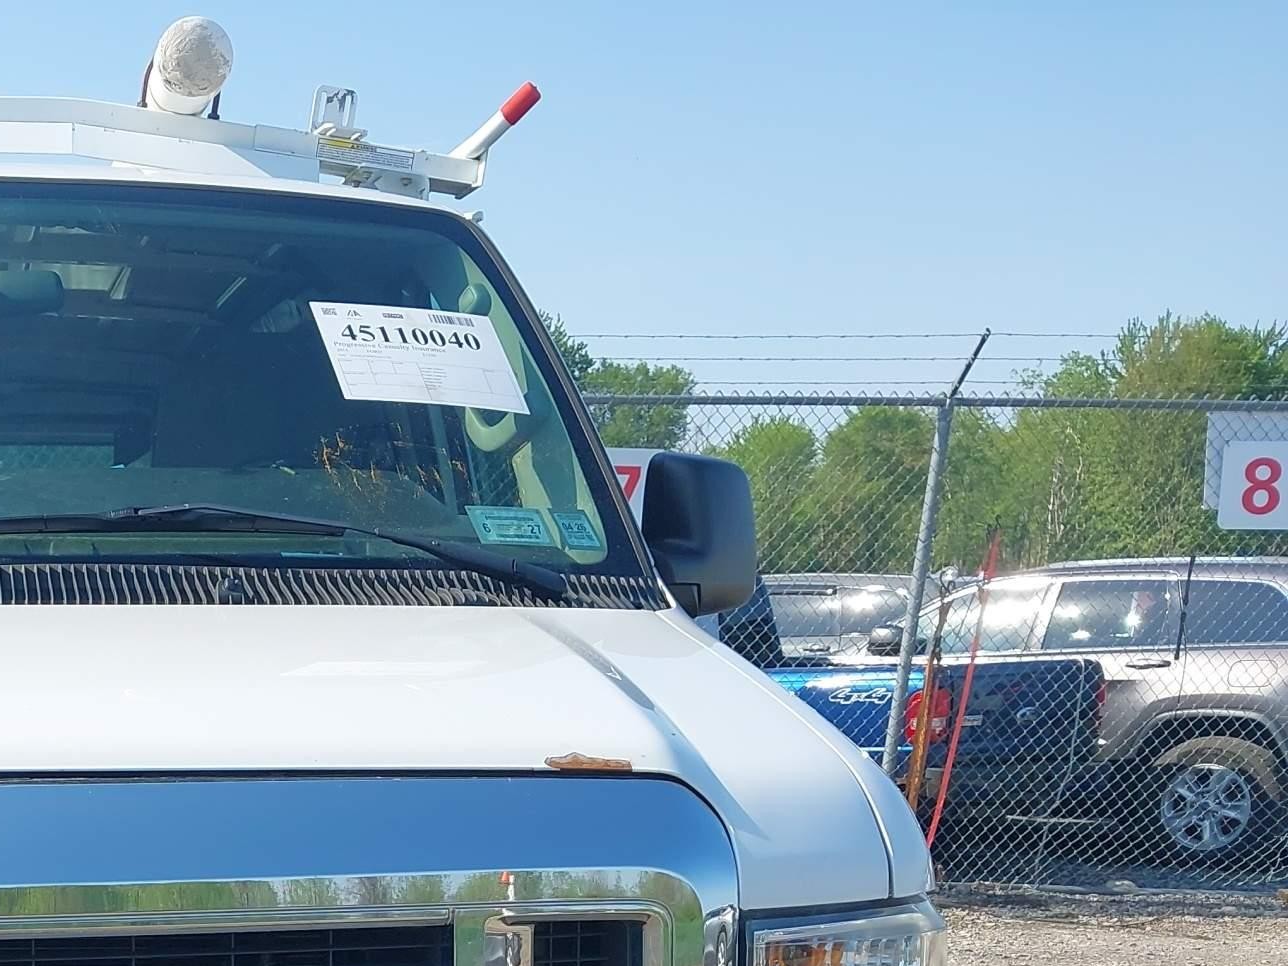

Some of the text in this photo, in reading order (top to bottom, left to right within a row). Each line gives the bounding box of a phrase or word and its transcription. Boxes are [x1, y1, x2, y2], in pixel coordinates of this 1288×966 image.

[341, 323, 481, 351] 45110040
[614, 466, 641, 502] 7
[1241, 456, 1283, 516] 8
[482, 522, 492, 533] 6
[528, 524, 542, 536] 27
